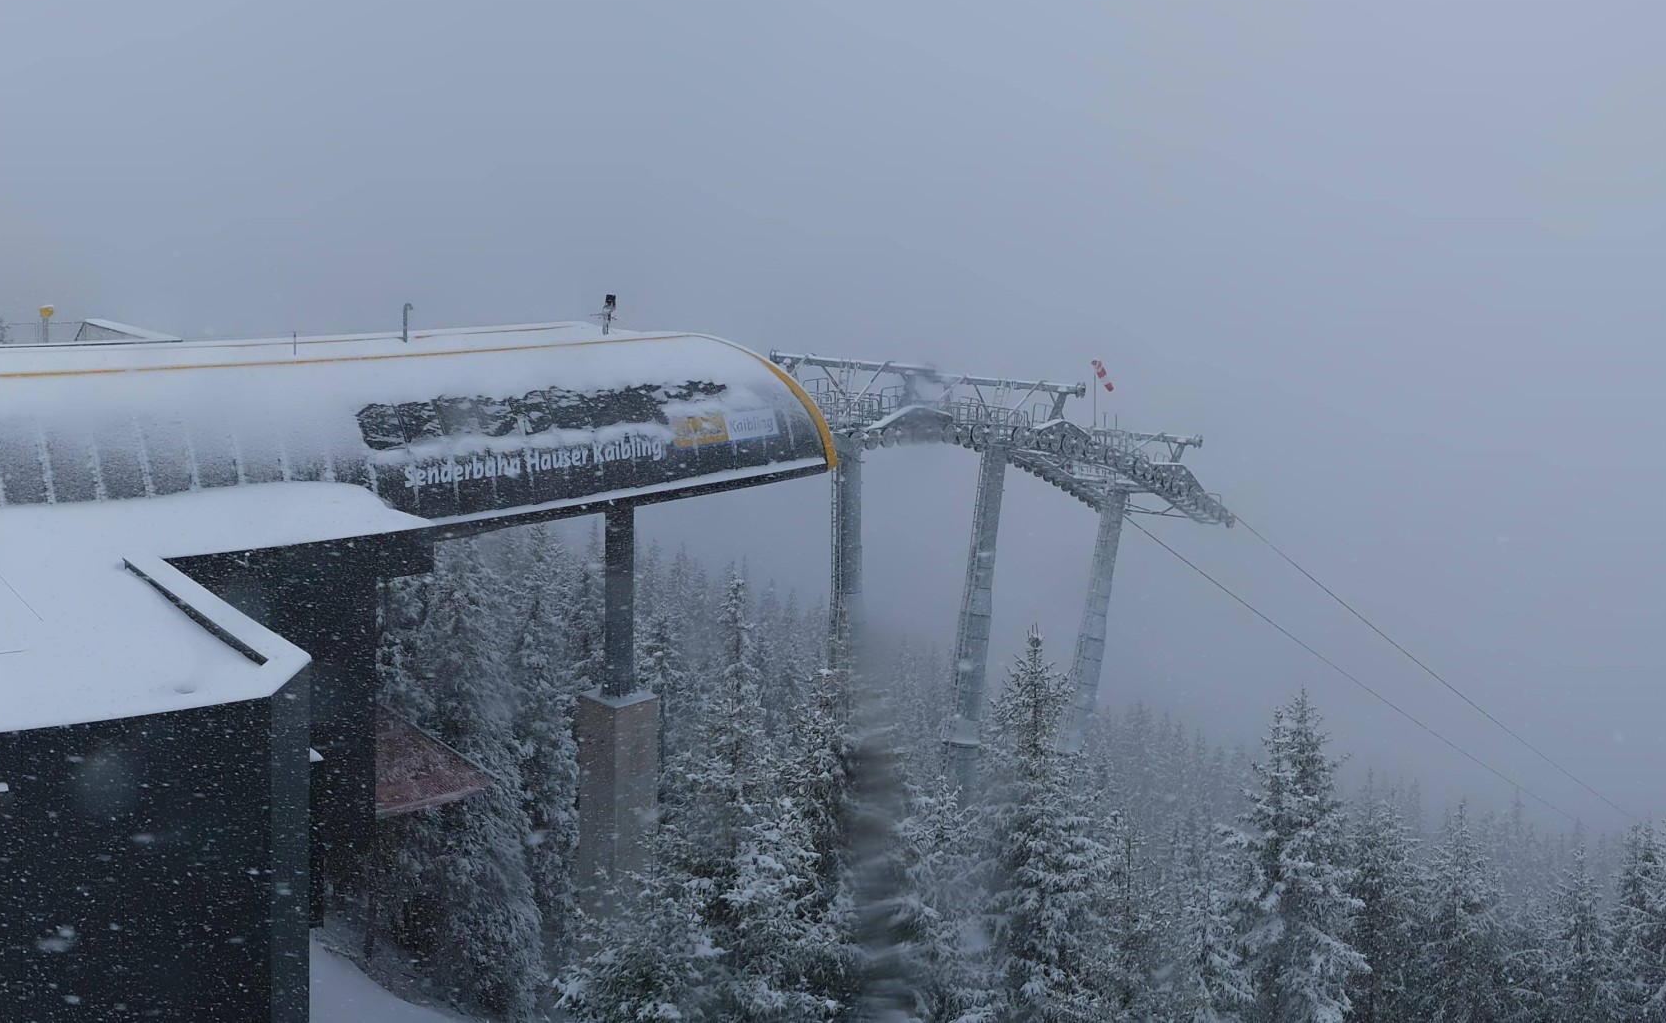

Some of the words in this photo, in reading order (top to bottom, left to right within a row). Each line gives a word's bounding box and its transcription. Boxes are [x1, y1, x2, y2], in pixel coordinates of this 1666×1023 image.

[729, 417, 774, 433] Kaibling
[404, 454, 521, 487] Senderbahn
[526, 448, 588, 471] Hauser
[593, 436, 664, 463] Kaibling
